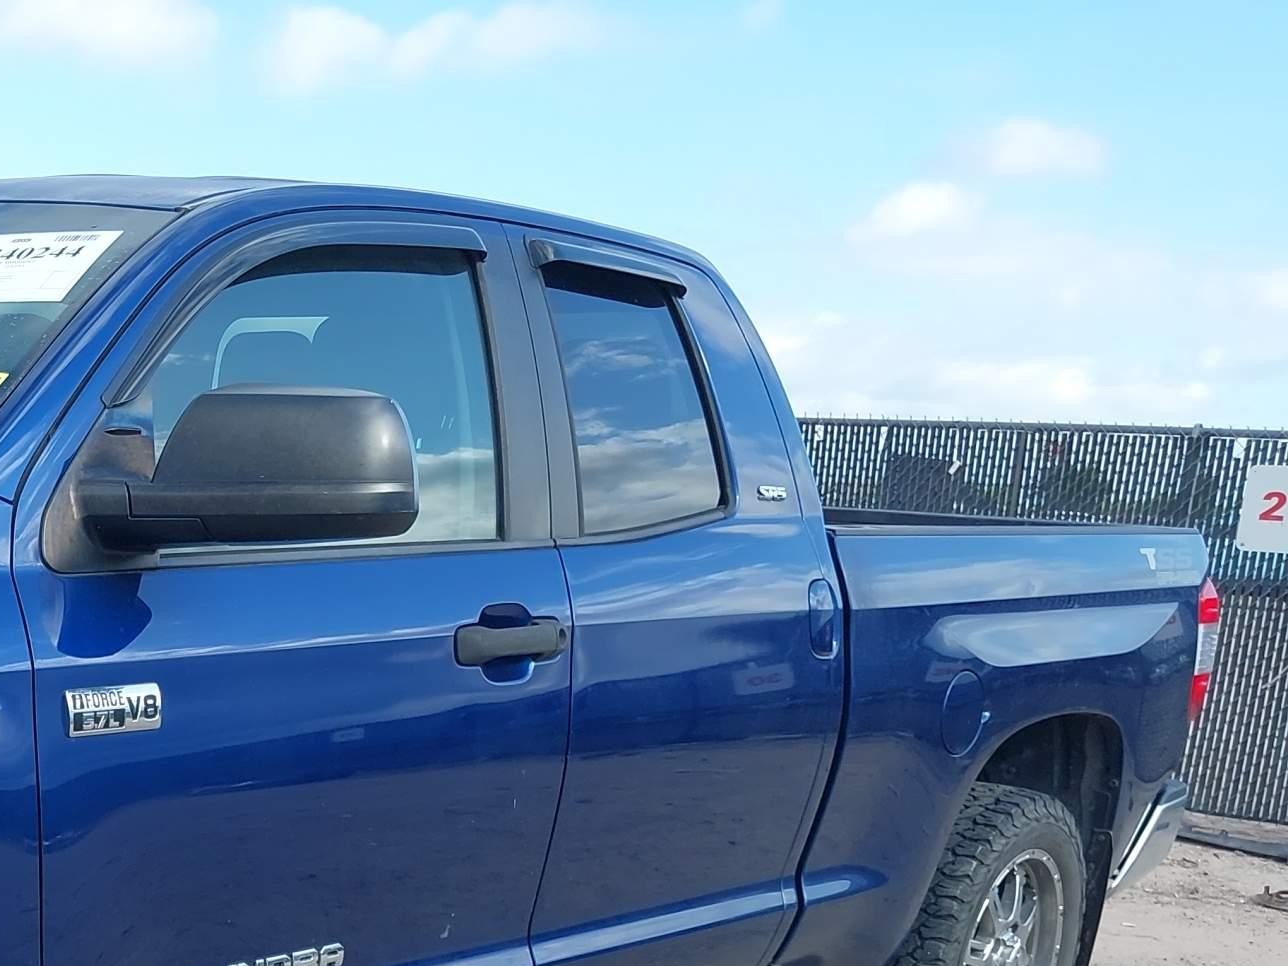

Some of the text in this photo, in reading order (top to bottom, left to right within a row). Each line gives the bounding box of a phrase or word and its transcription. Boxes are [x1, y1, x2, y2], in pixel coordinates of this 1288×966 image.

[1257, 491, 1288, 522] 2
[82, 710, 121, 730] 5.7L
[126, 694, 160, 721] V8
